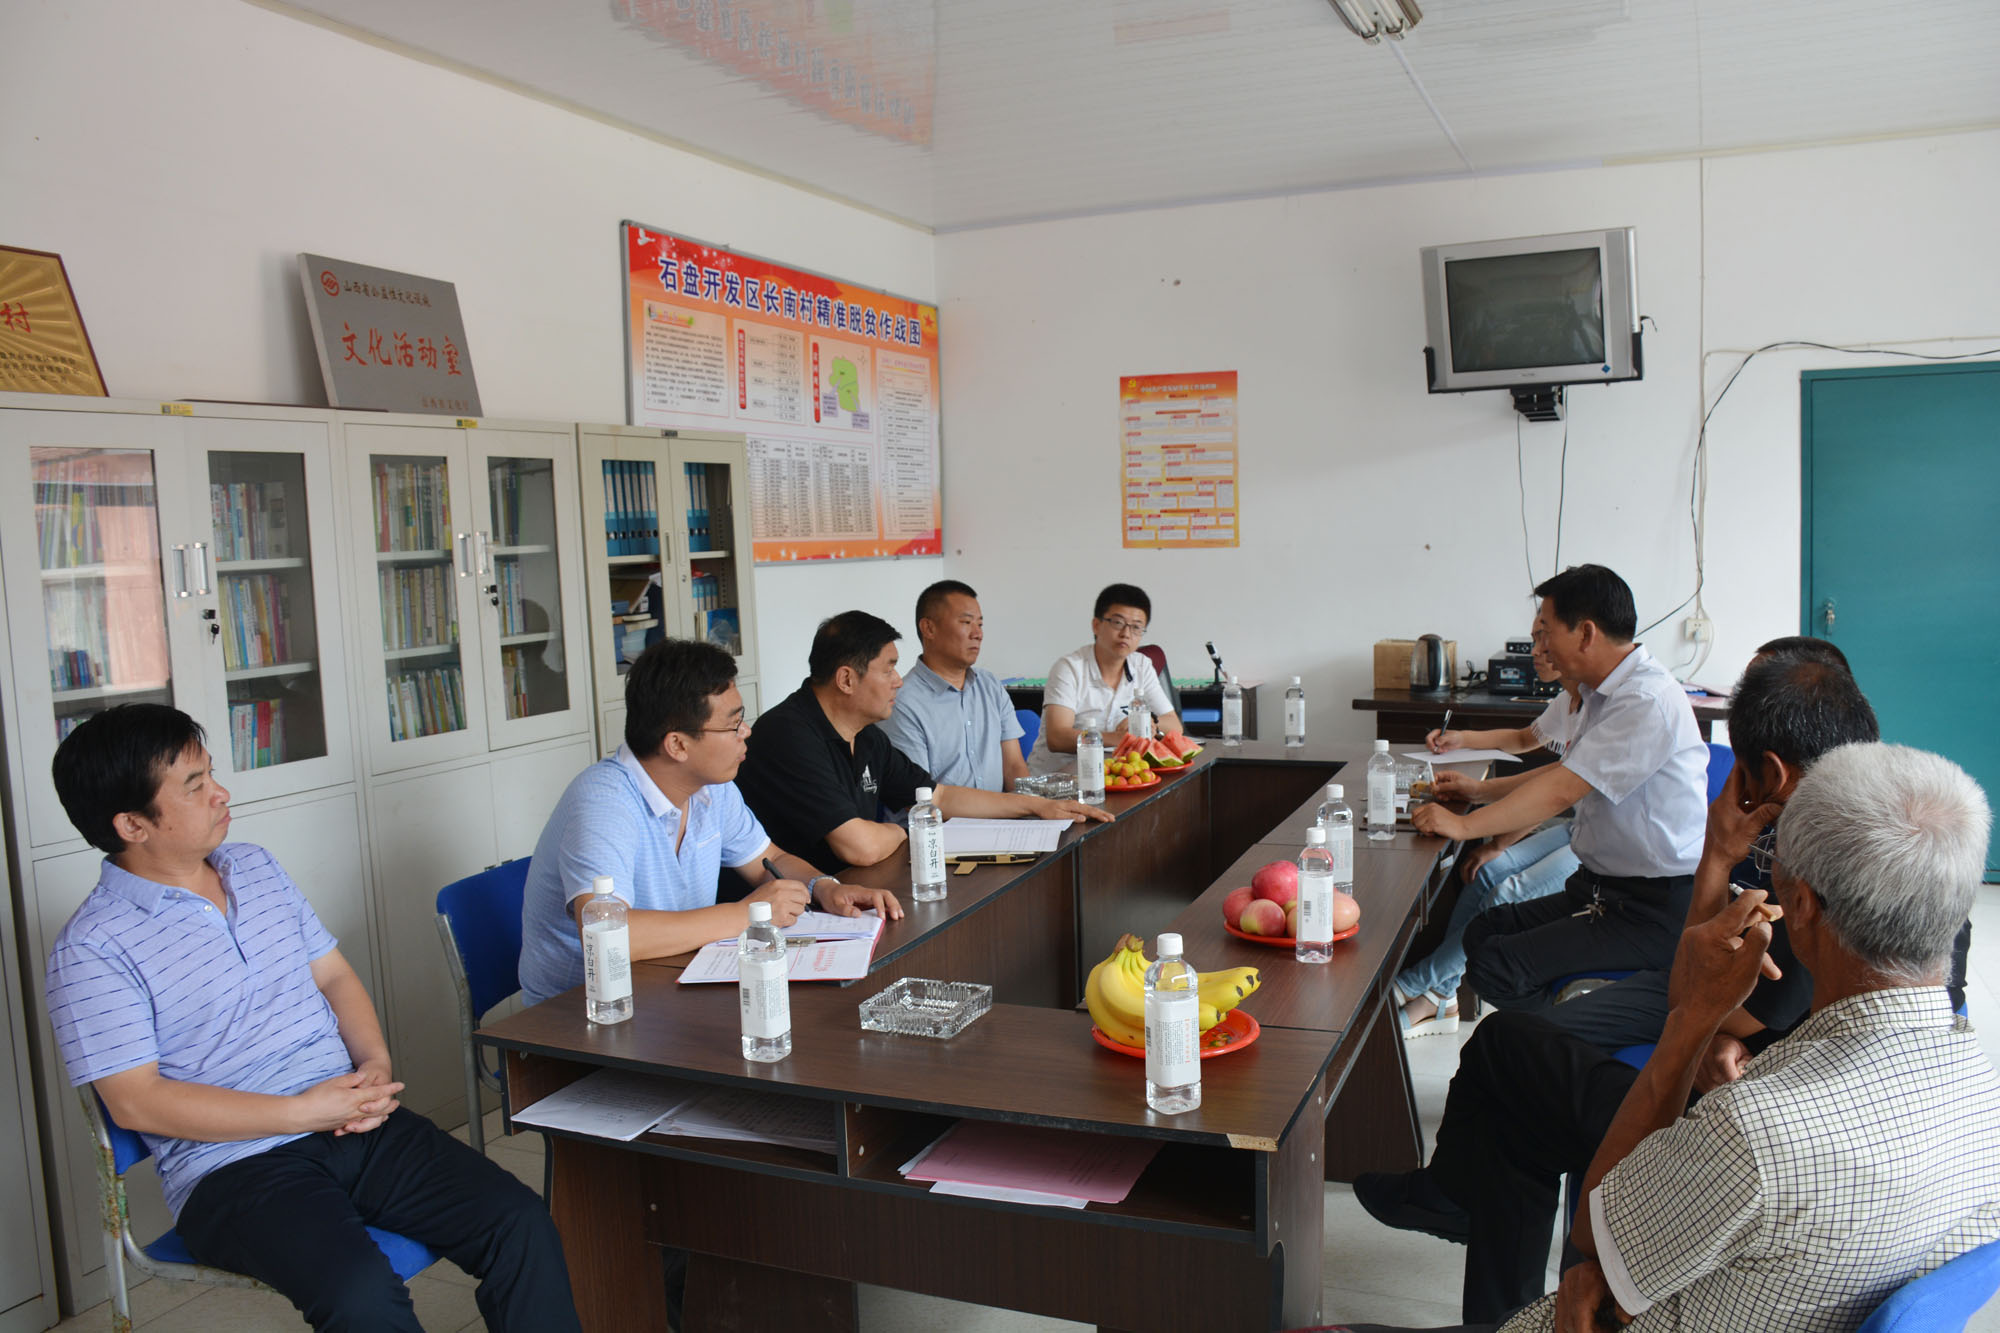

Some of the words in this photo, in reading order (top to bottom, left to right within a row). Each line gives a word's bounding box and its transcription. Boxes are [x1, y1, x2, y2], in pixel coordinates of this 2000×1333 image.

[0, 301, 32, 333] 村
[658, 258, 922, 346] 石盘开发区长南村精准脱贫作战图
[341, 320, 463, 376] 文化活动室
